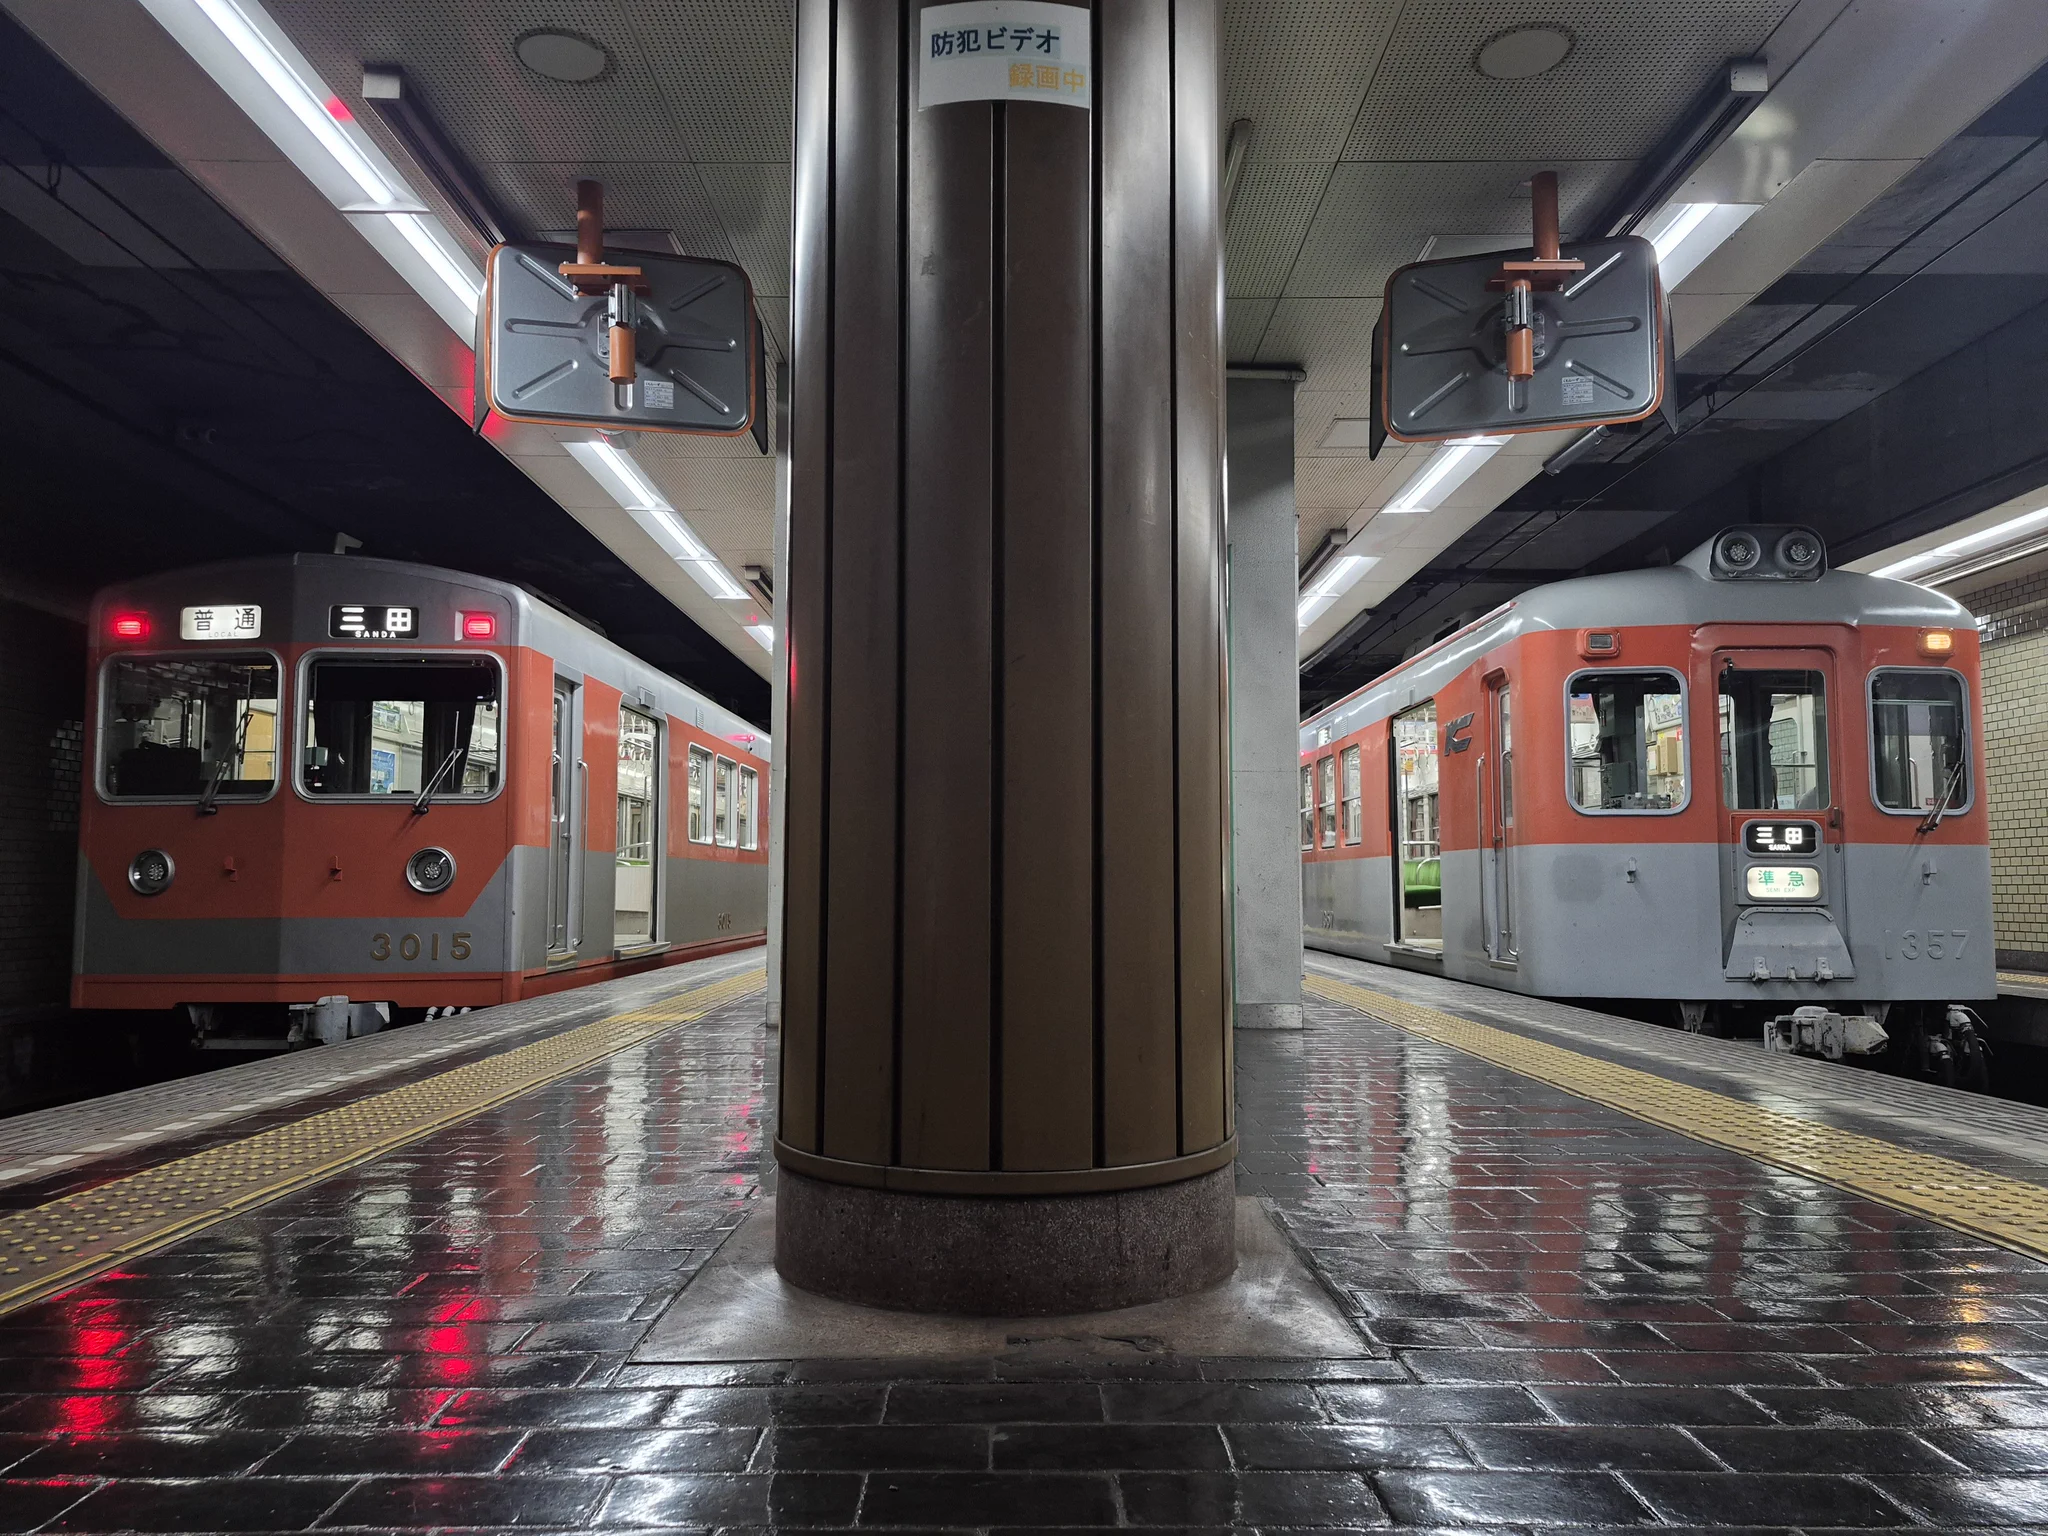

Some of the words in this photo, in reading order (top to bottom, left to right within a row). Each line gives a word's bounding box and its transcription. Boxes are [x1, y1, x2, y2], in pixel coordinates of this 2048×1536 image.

[931, 26, 1060, 58] 防犯ビデオ
[1009, 63, 1085, 93] 録画中
[193, 607, 256, 631] 普通
[339, 606, 412, 632] 三田
[354, 630, 397, 639] SANDA
[1756, 826, 1803, 845] 三田
[1768, 843, 1792, 851] SANDA
[1758, 869, 1805, 887] 準急
[369, 931, 473, 962] 3015
[1883, 929, 1970, 961] 1357
